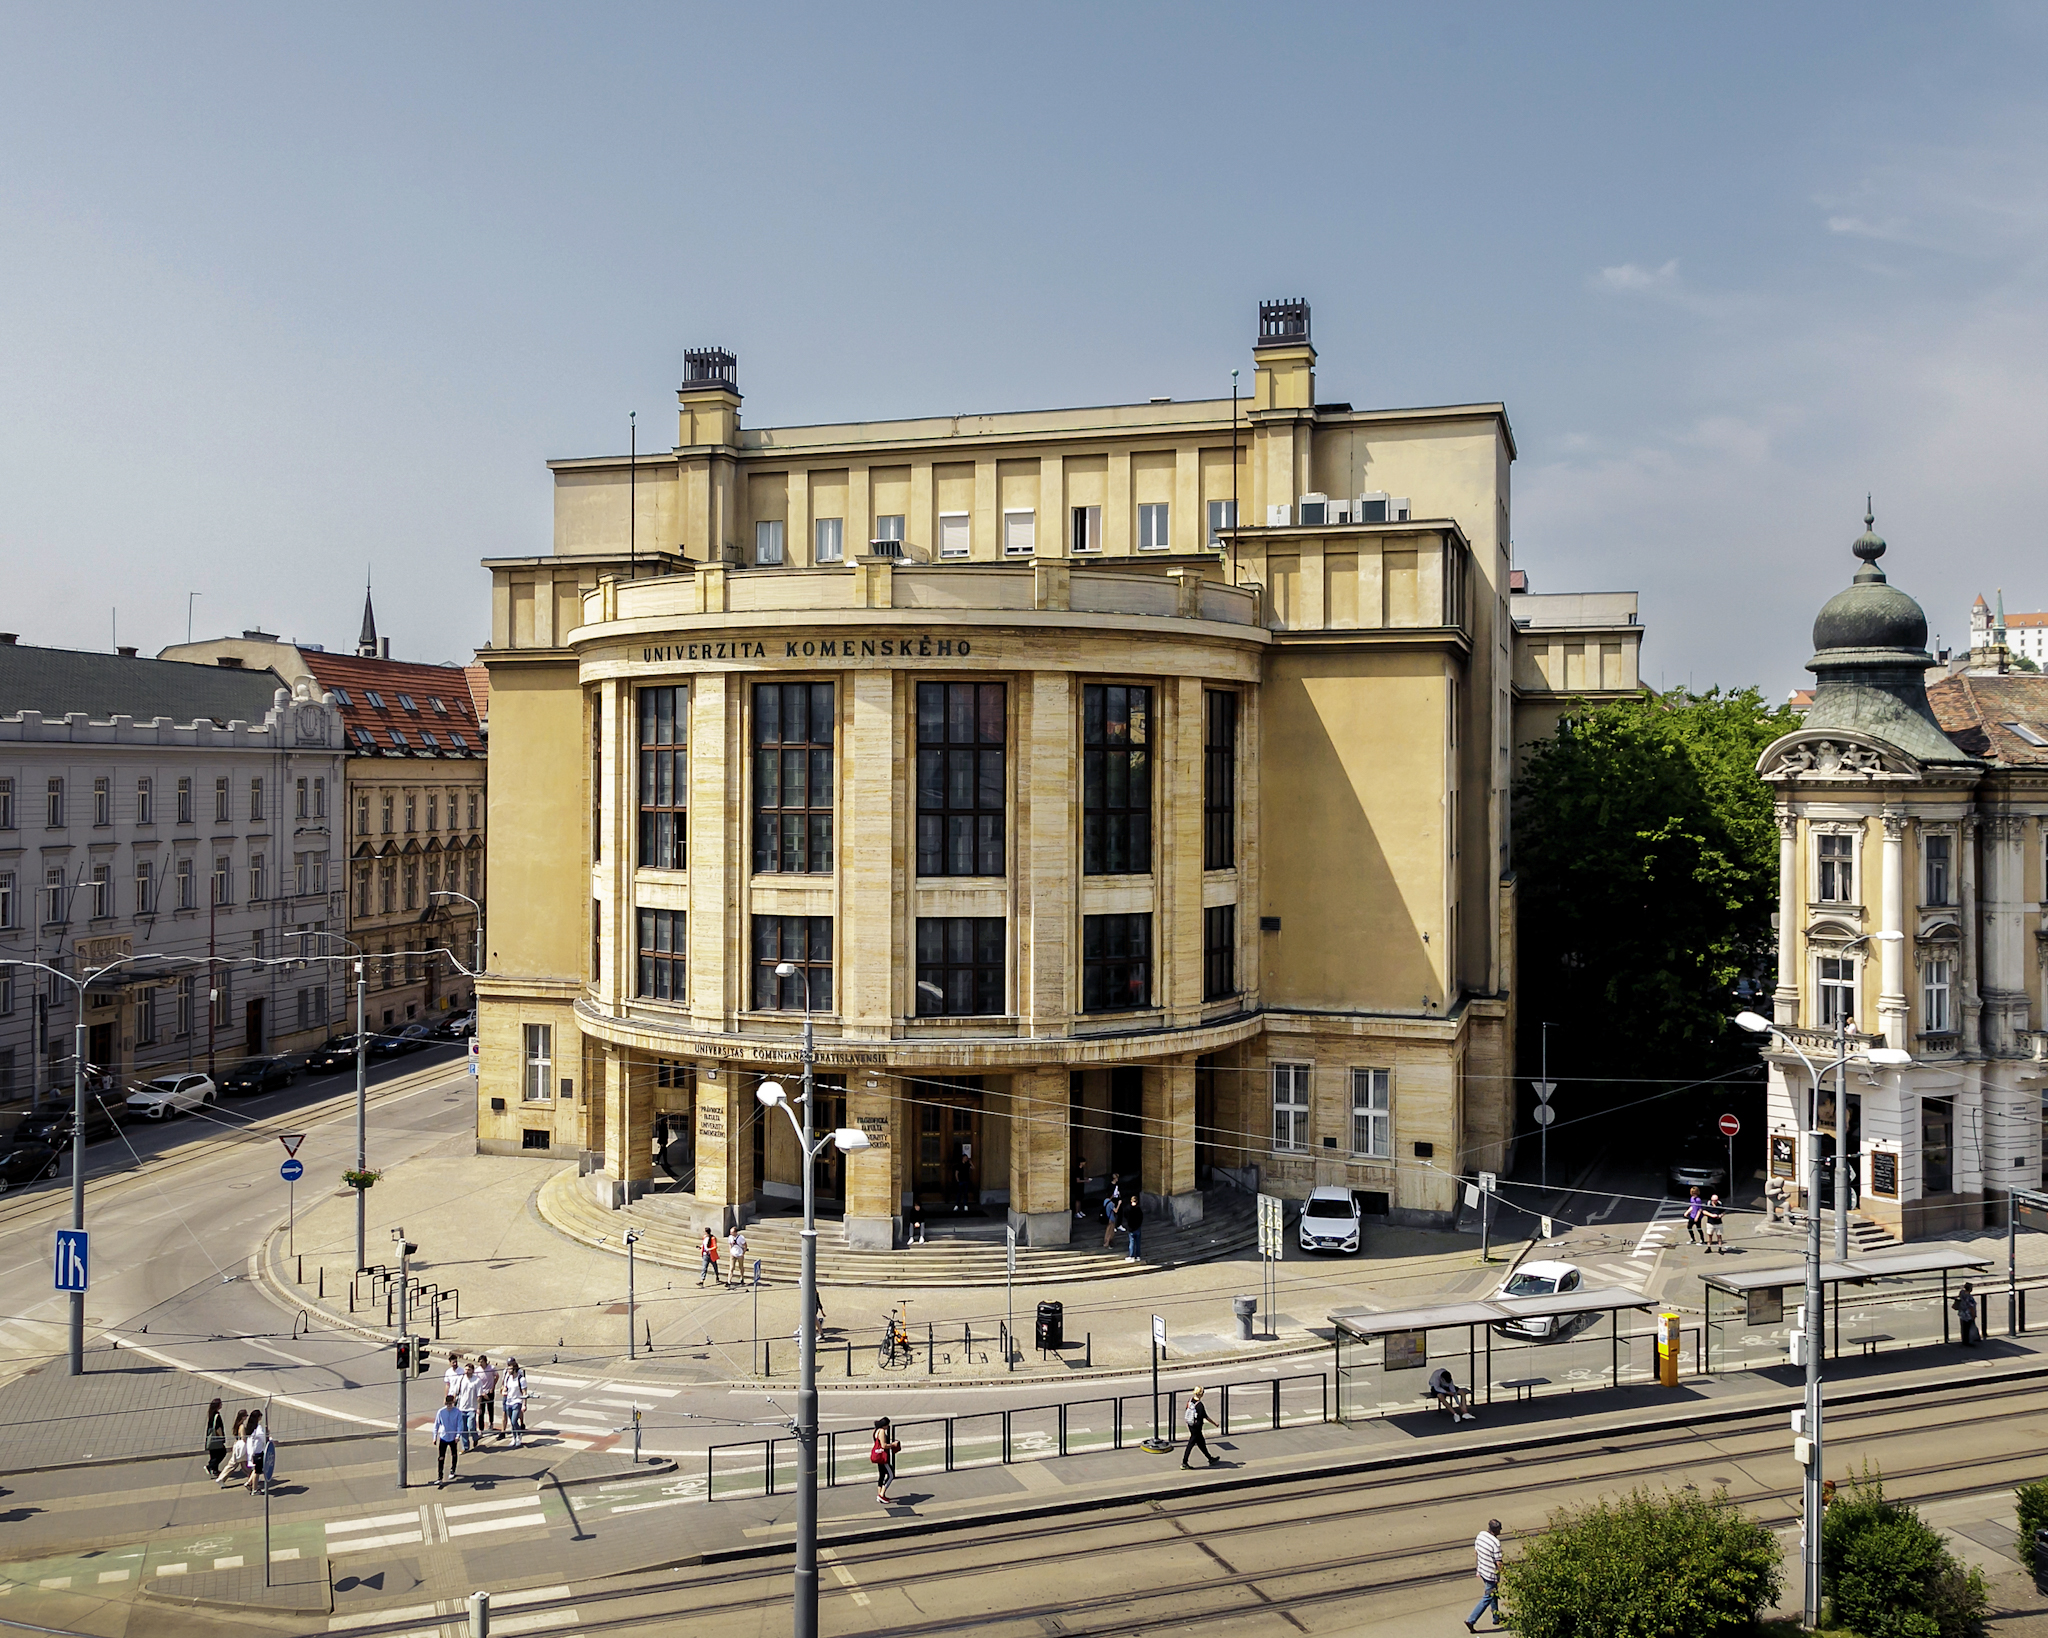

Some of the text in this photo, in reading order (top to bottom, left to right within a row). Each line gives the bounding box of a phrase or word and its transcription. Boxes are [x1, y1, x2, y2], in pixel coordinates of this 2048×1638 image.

[643, 635, 971, 662] UNIVERZITA KOMENSKÉHO
[695, 1044, 744, 1058] UNIVERSITAS
[815, 1052, 887, 1064] BRATISLAVENSIS
